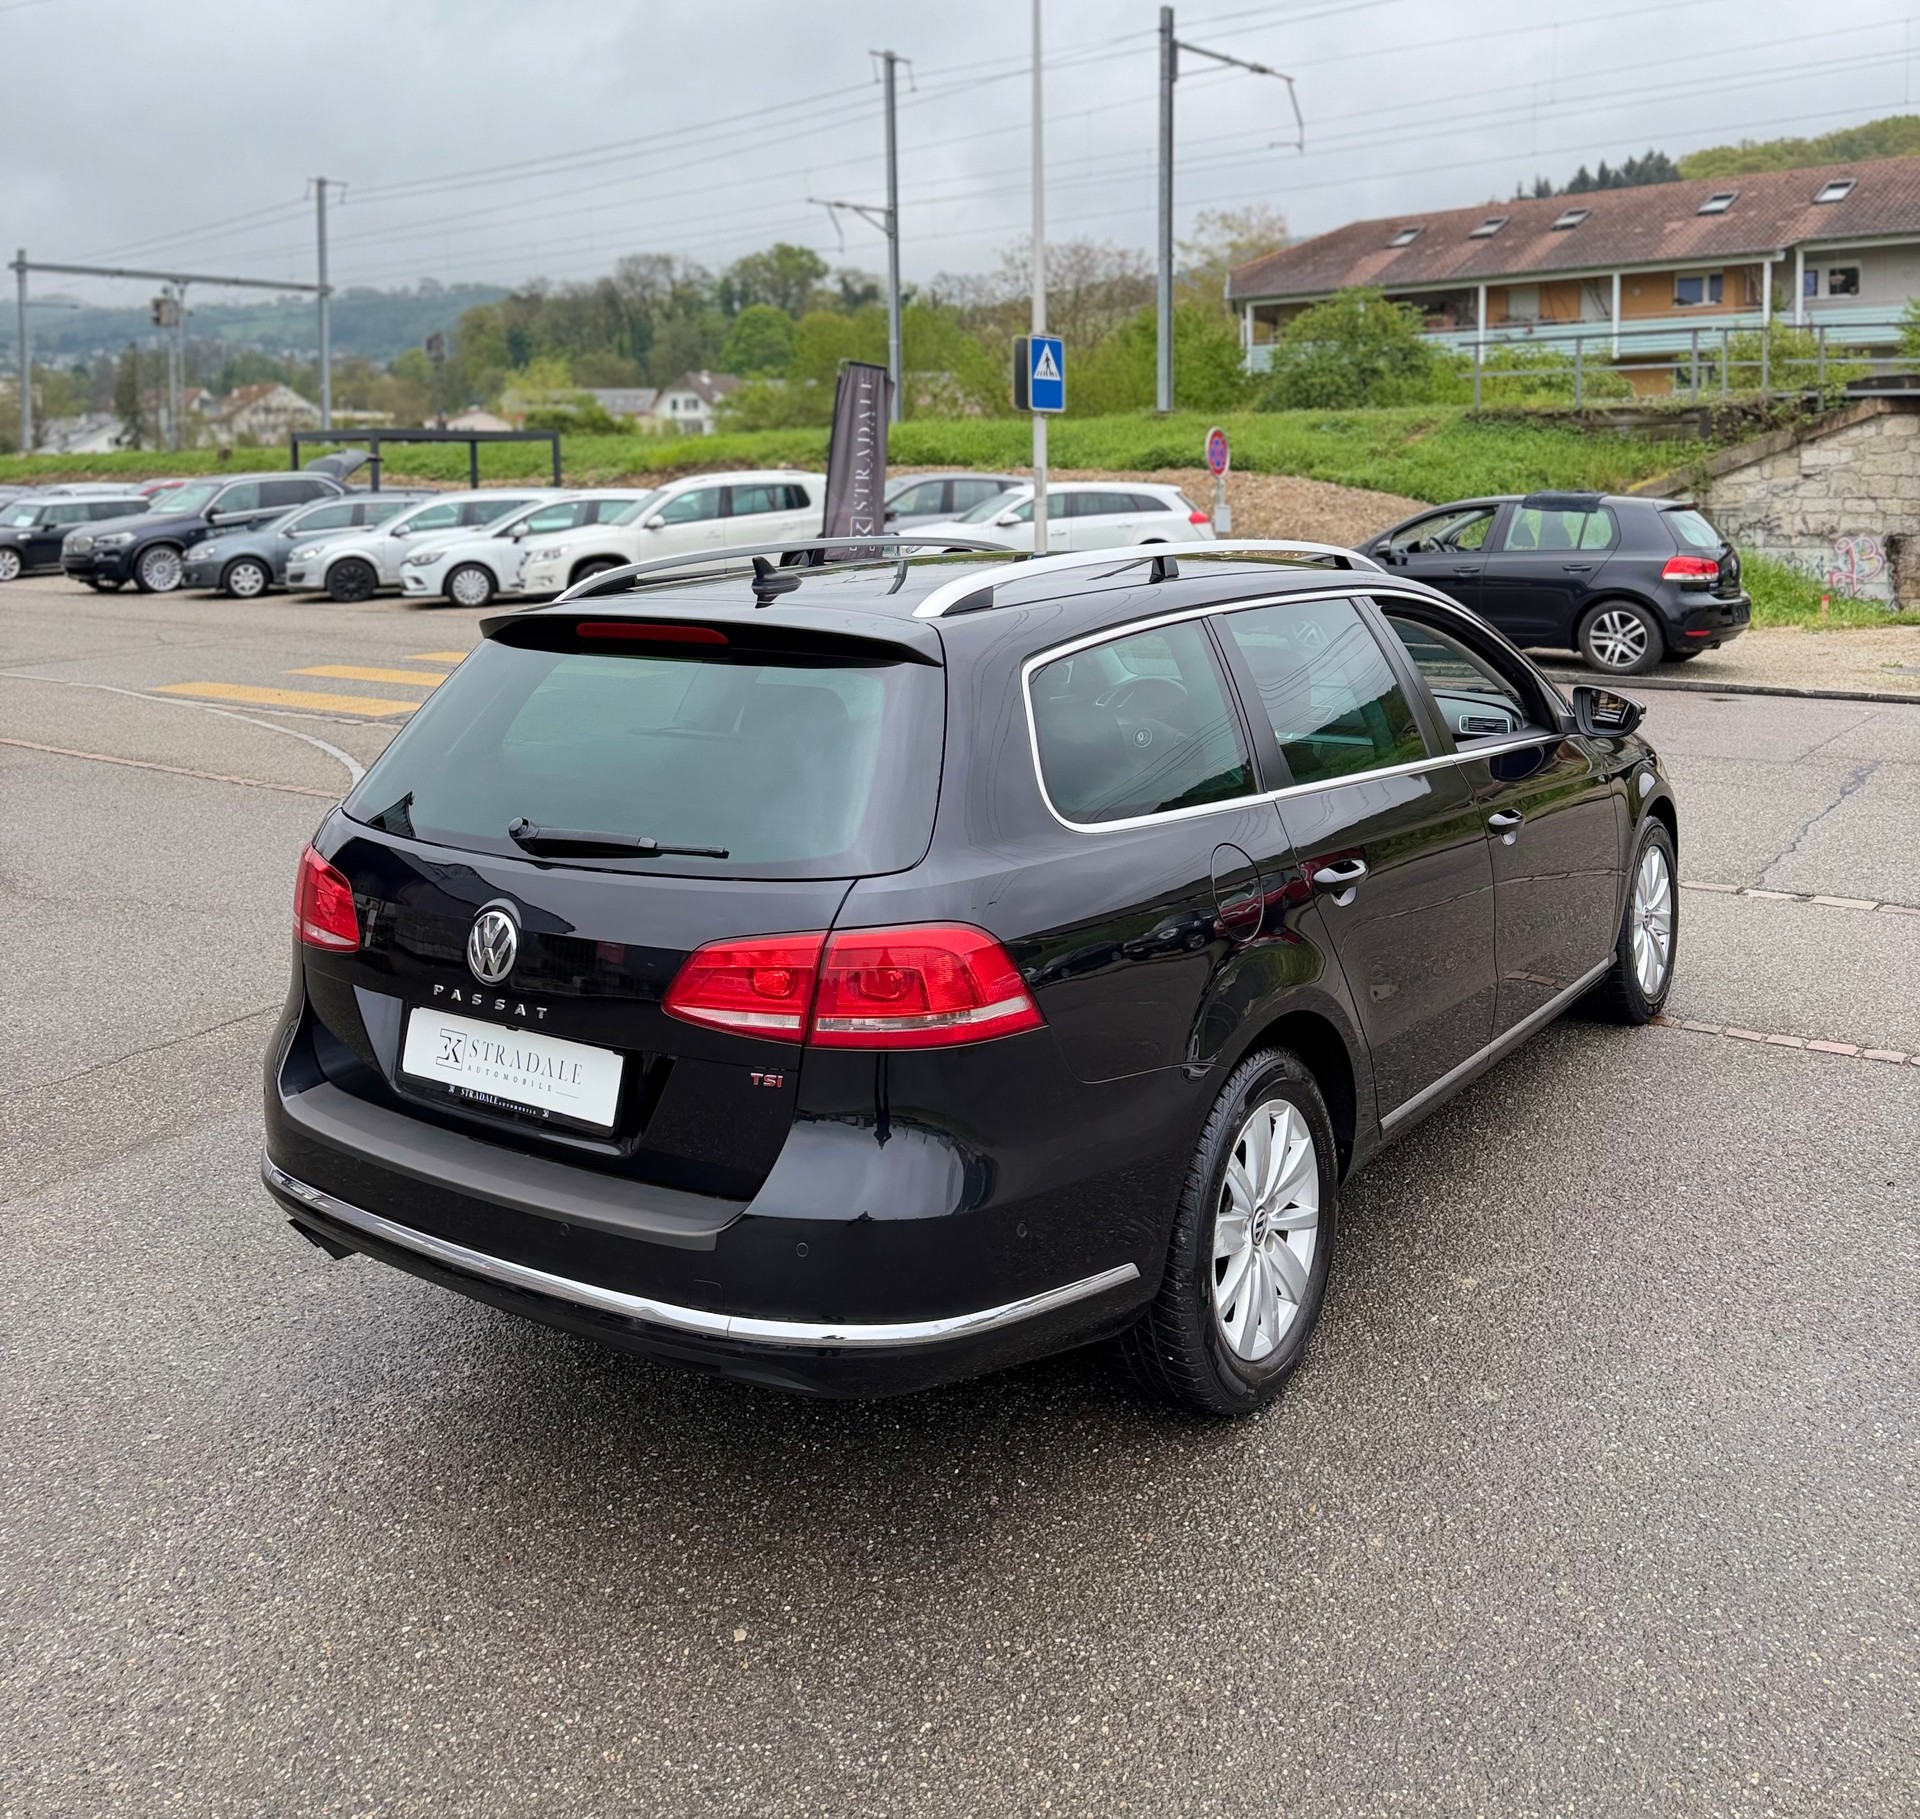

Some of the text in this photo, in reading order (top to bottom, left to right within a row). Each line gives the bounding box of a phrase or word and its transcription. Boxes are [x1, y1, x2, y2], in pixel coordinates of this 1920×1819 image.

[433, 984, 548, 1019] PASSAT
[468, 1038, 583, 1085] STRADALE
[467, 1064, 552, 1092] AUTOMOBILE
[750, 1072, 784, 1088] TSI
[460, 1087, 498, 1105] STRADALE
